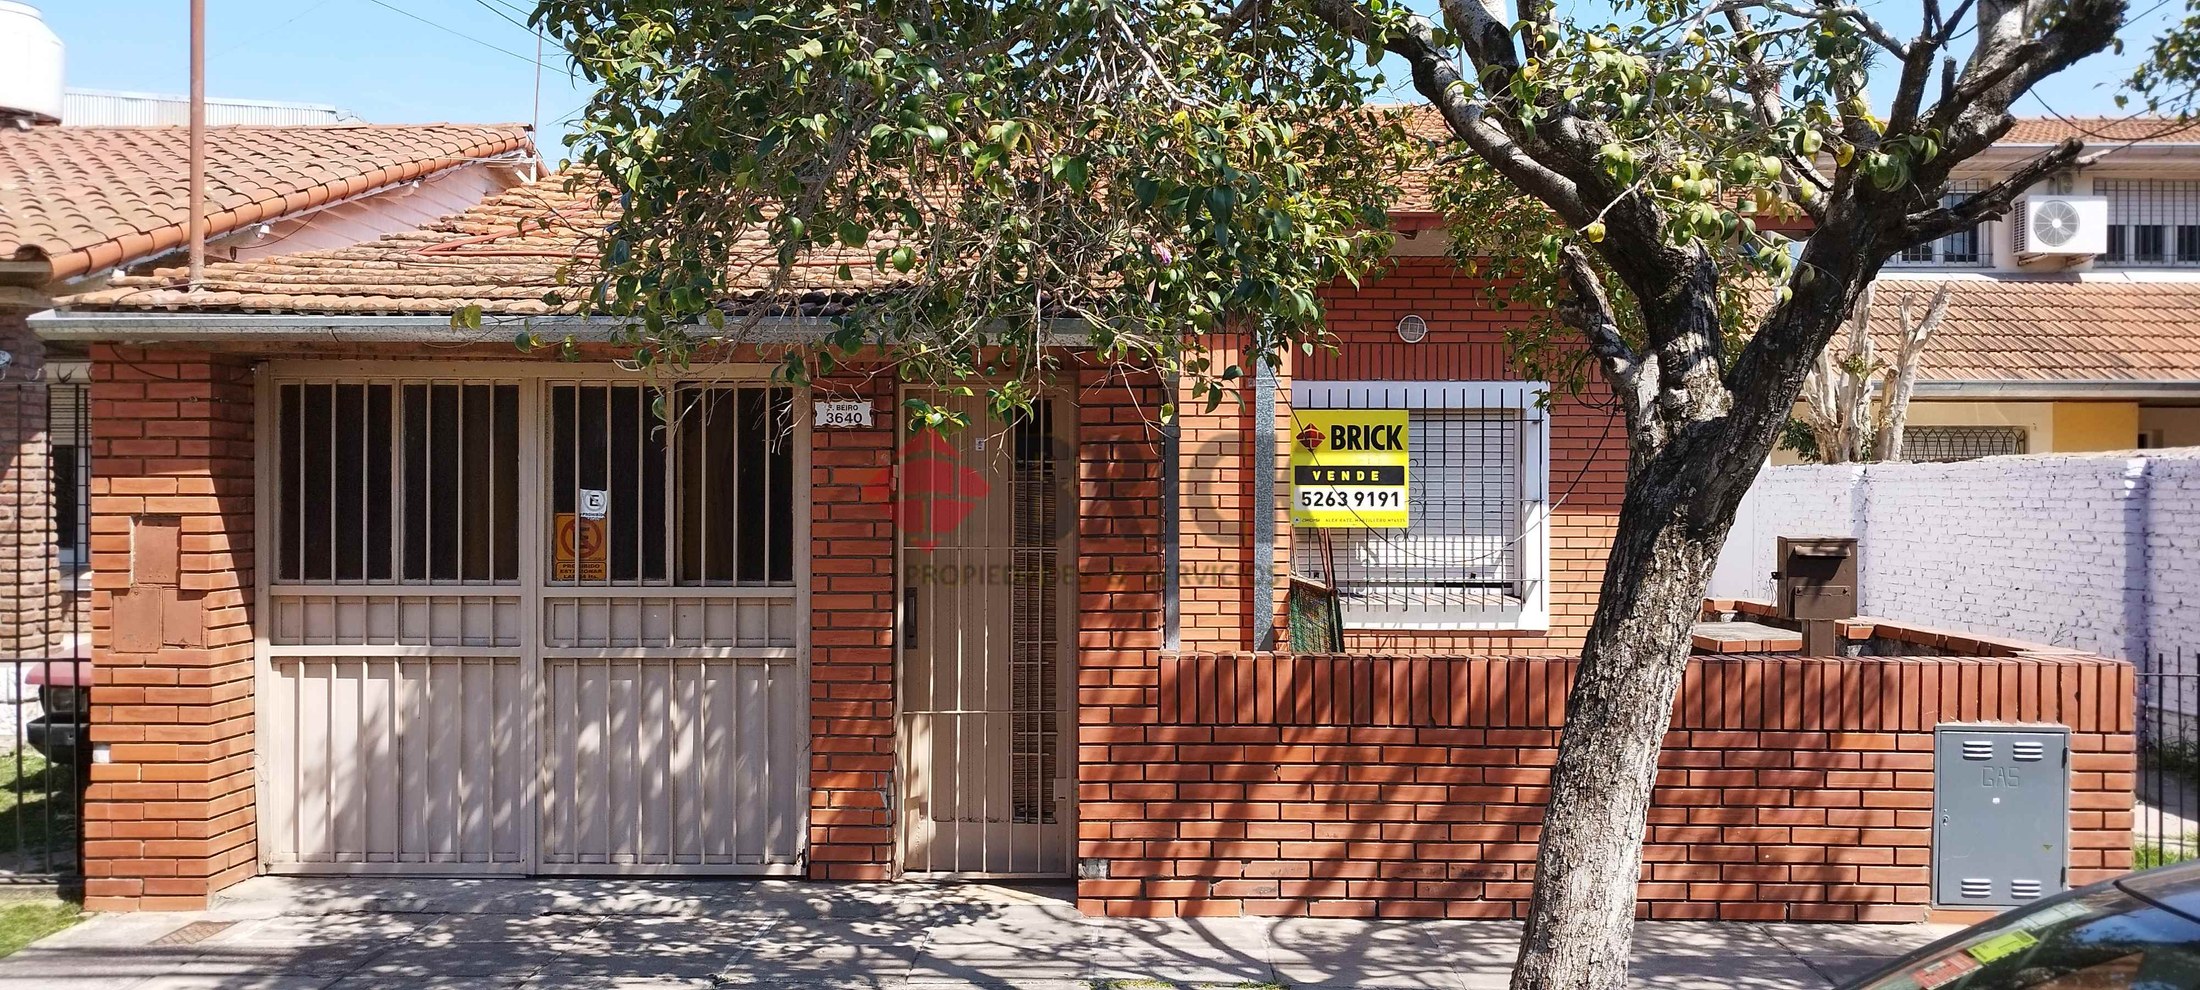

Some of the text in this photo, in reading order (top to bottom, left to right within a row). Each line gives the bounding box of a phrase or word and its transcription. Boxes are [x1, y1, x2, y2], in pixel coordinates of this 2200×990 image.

[826, 412, 863, 424] 3640
[1330, 424, 1404, 451] BRICK
[1312, 470, 1381, 481] VENDE
[1301, 491, 1399, 507] 5263 9191
[1981, 765, 2020, 788] GAS
